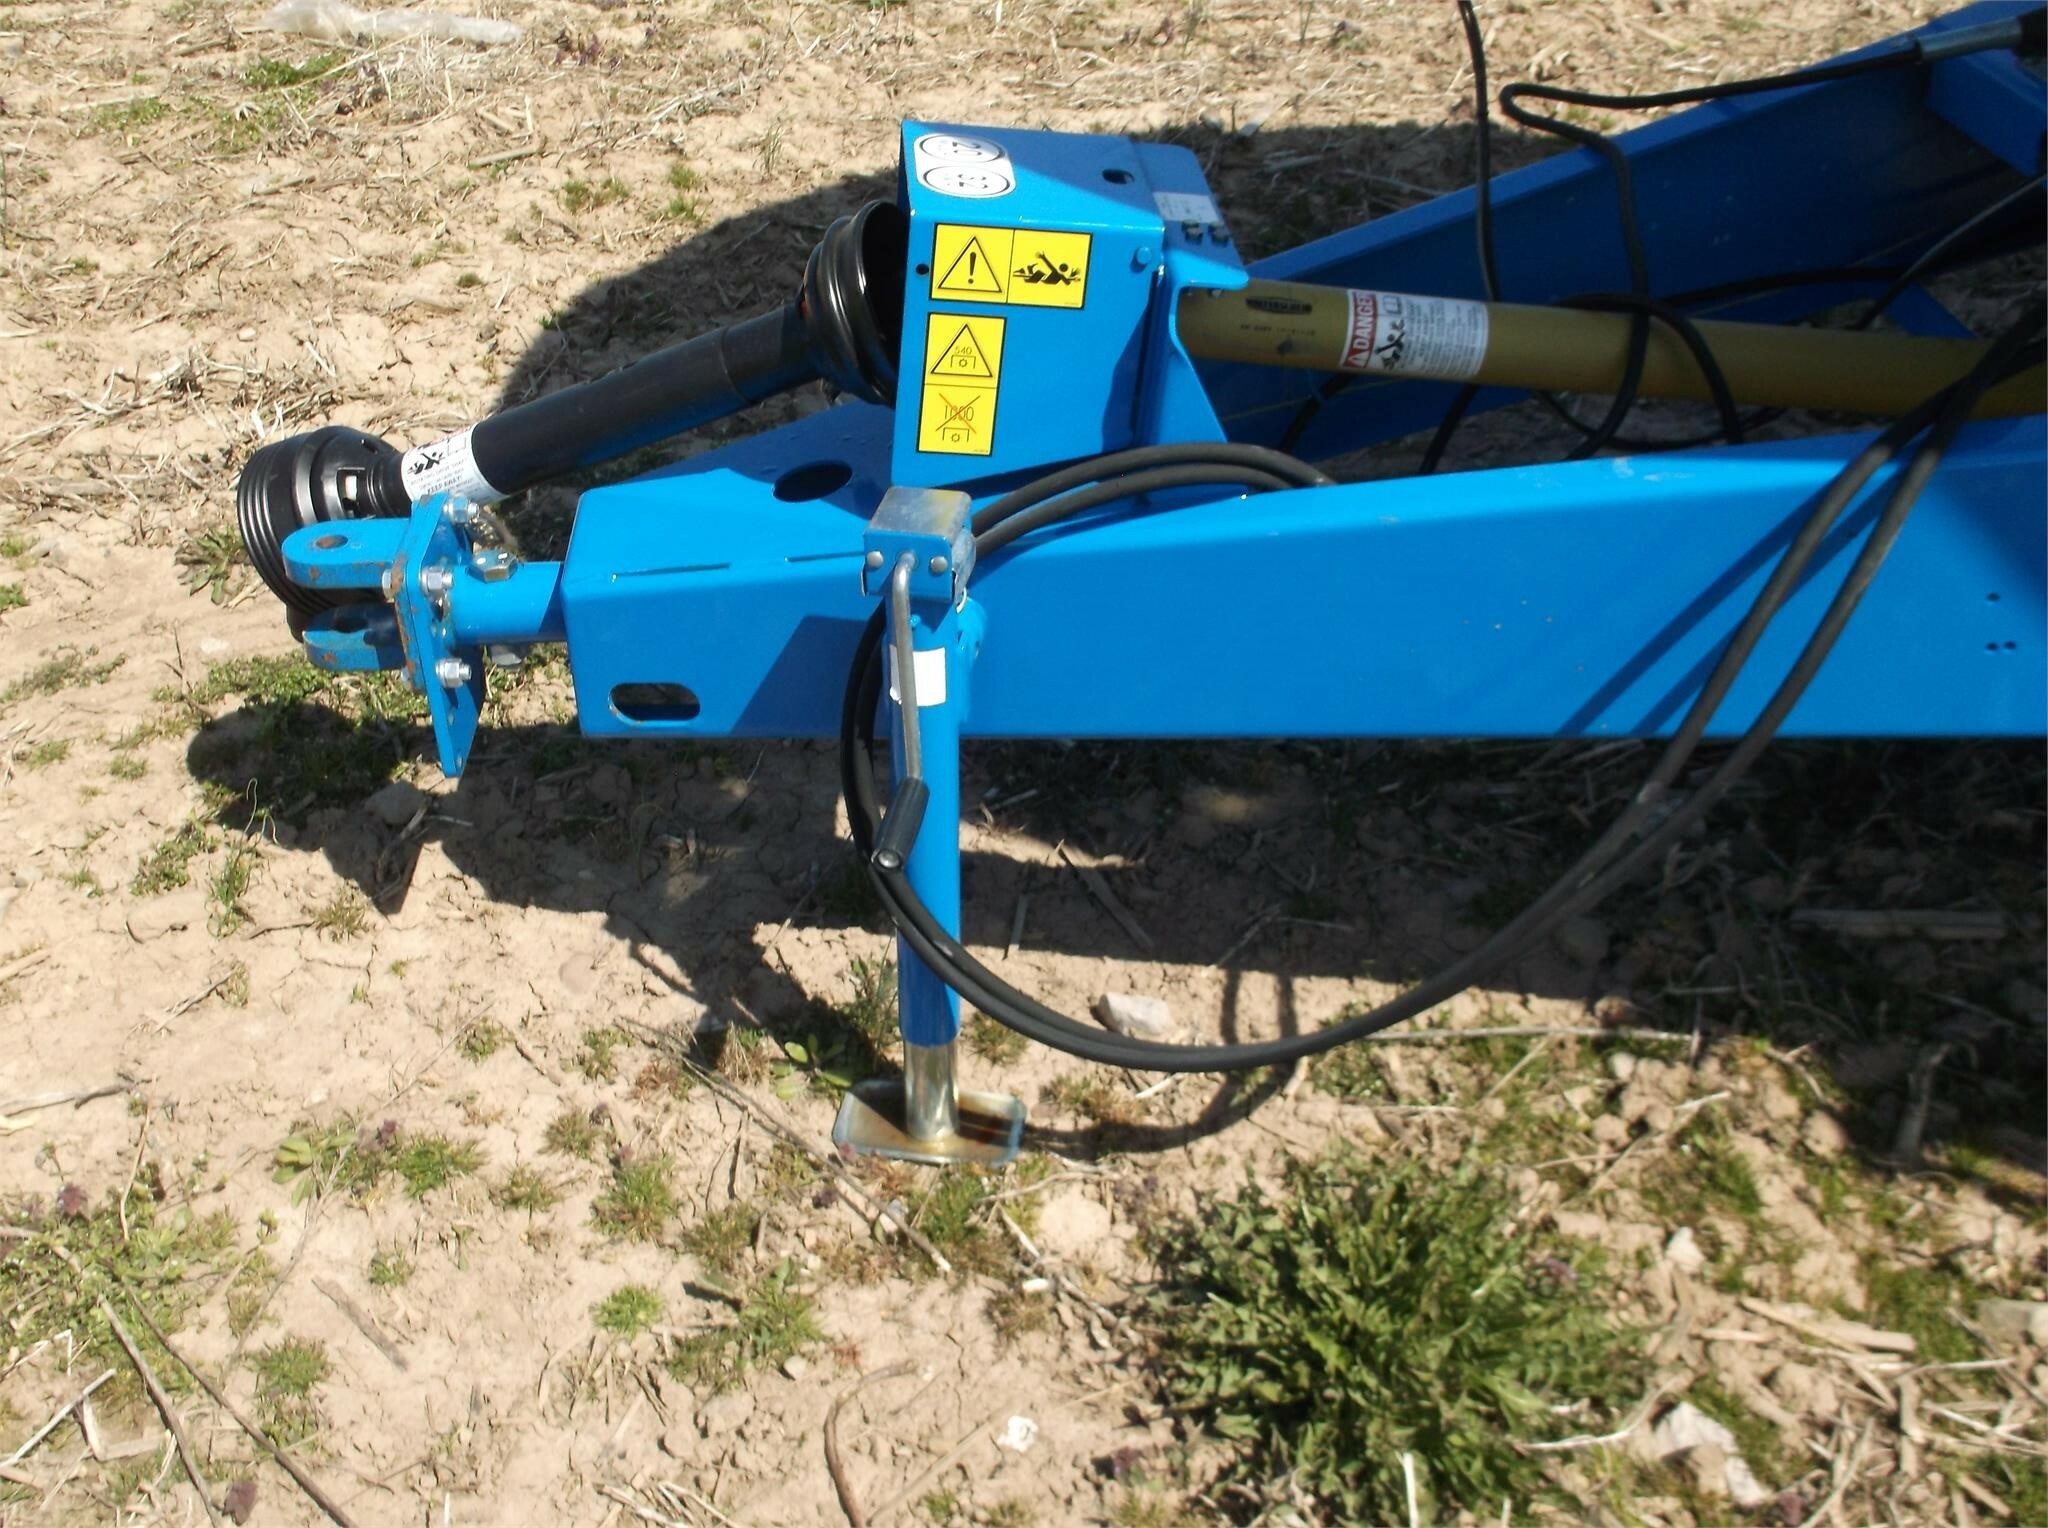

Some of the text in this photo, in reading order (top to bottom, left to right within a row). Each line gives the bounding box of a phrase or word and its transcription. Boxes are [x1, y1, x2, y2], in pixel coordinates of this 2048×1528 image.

[1353, 294, 1373, 350] DANGE
[955, 345, 972, 356] 540
[944, 404, 974, 422] 1000
